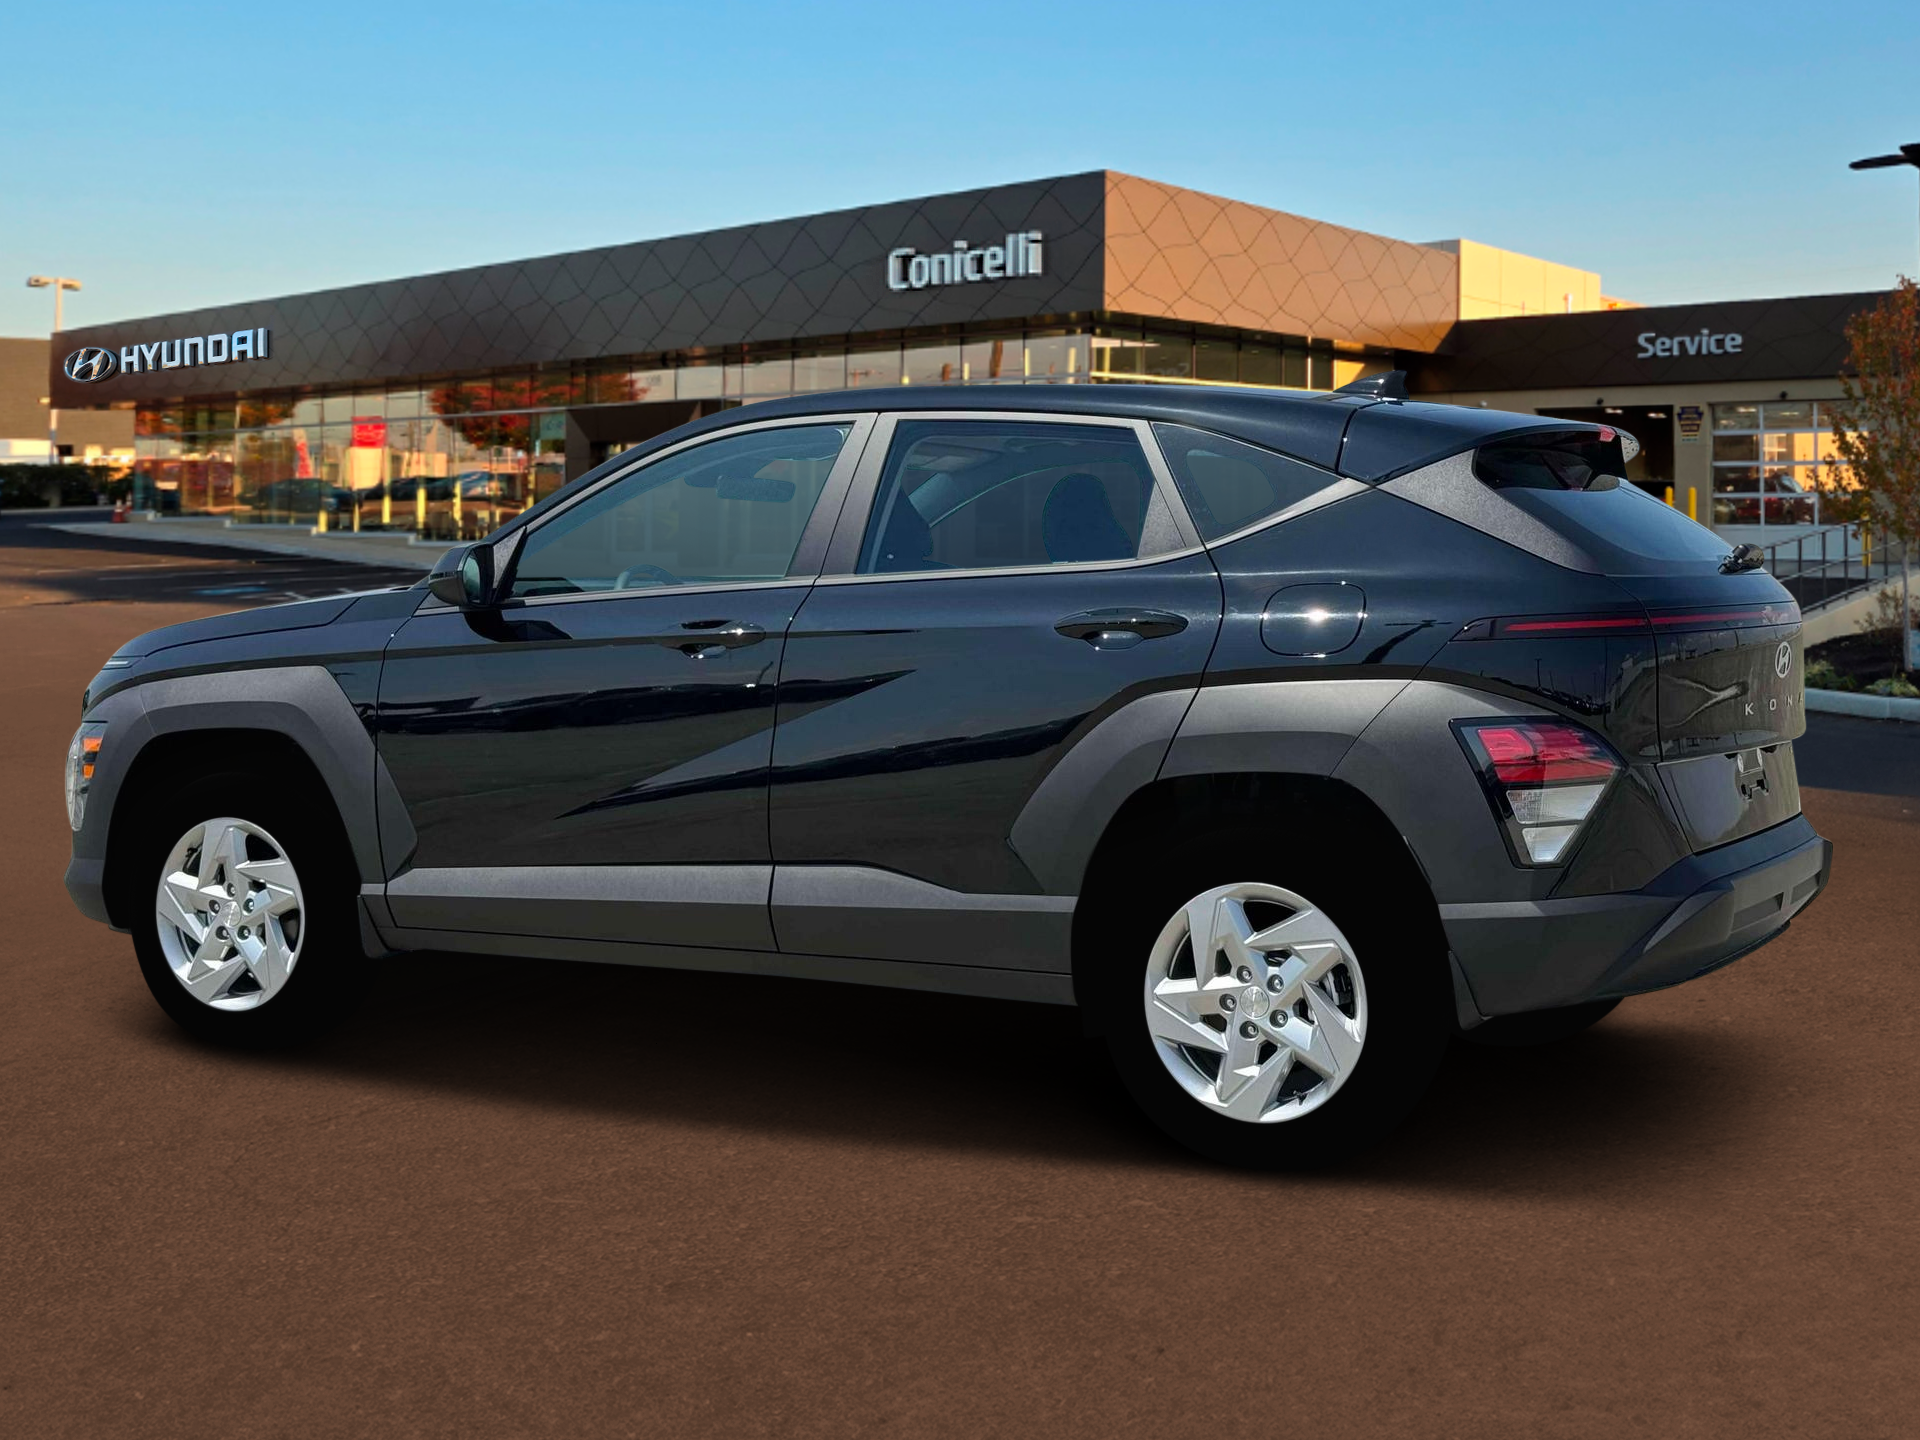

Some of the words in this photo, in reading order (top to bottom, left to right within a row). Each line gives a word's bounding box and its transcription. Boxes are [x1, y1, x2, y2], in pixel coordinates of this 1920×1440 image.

[888, 230, 1043, 290] Conicelli
[120, 327, 270, 374] HYUNDAI
[1637, 328, 1743, 359] Service
